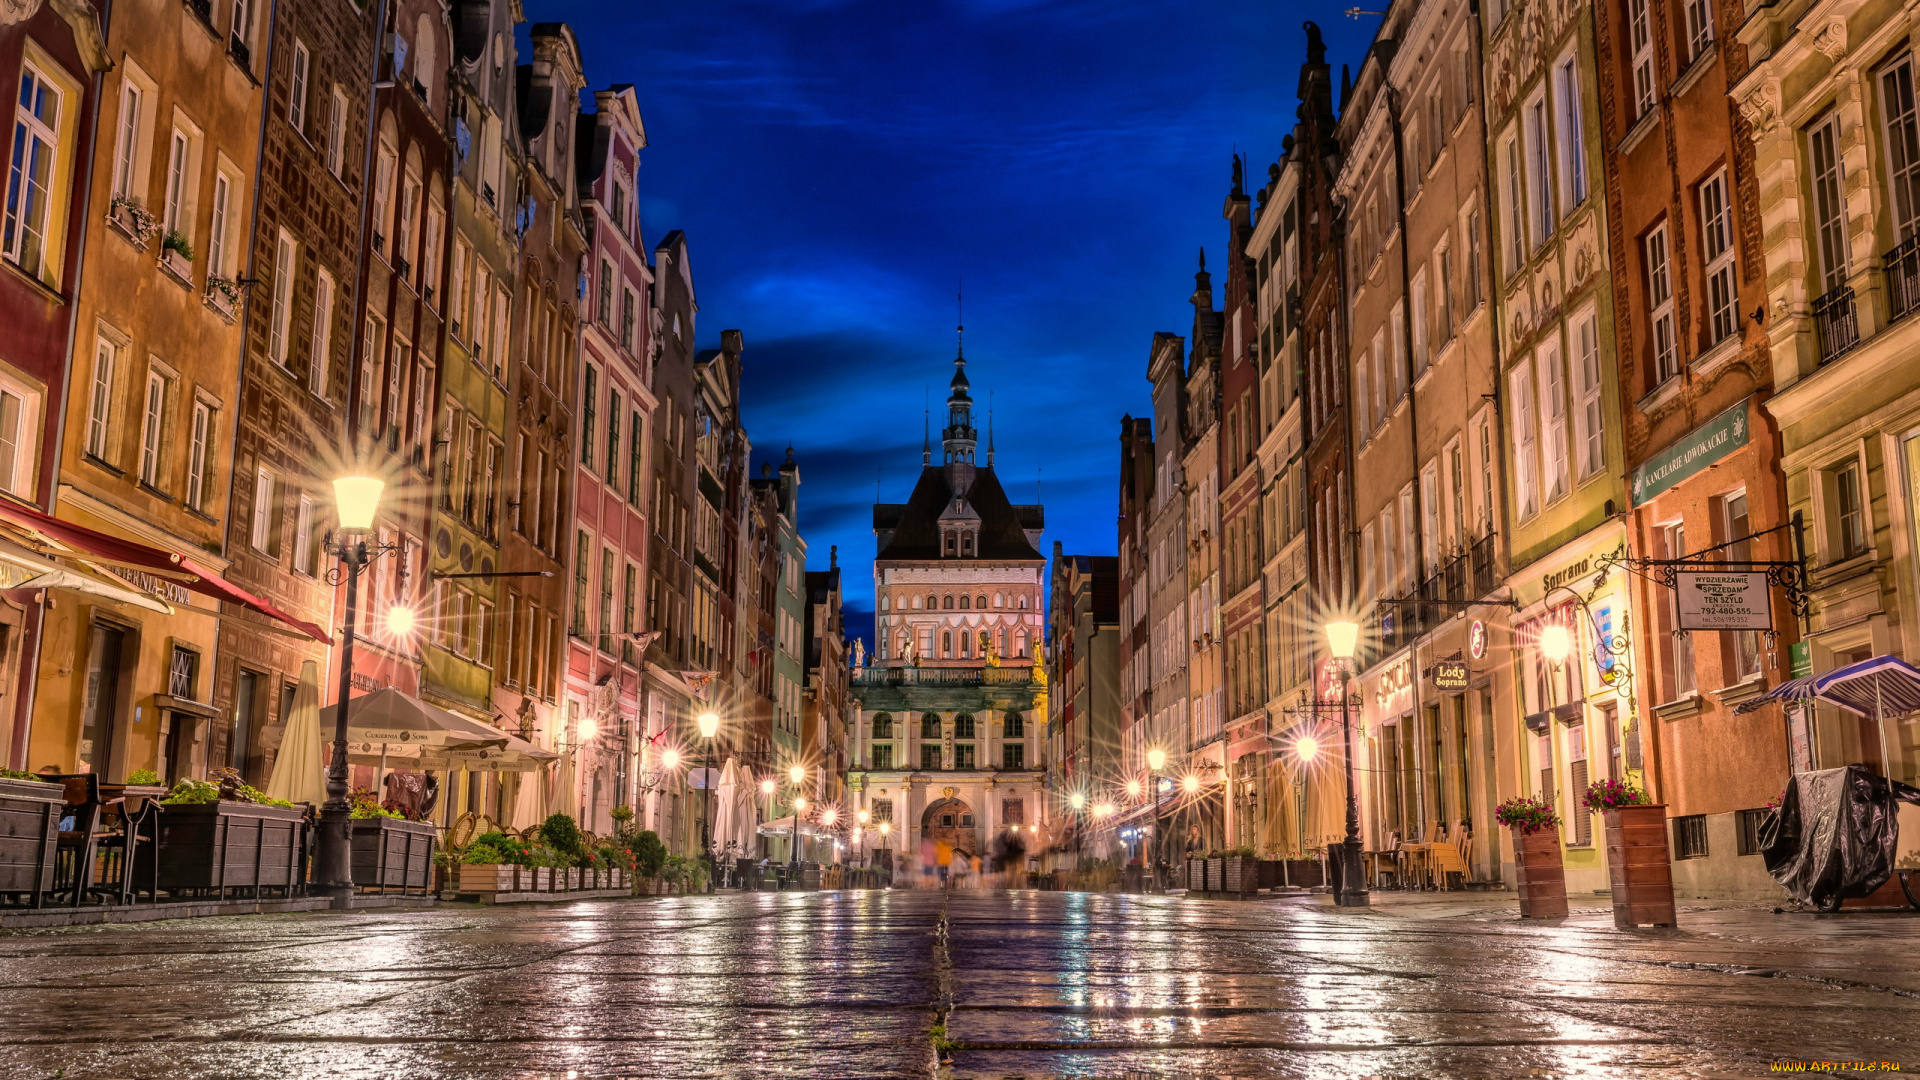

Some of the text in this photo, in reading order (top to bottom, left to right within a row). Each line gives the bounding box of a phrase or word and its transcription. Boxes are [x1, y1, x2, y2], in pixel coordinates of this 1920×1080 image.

[1645, 428, 1729, 488] KANCELARIE ADWOKACKIE
[1543, 558, 1590, 592] Soprano
[1704, 596, 1718, 604] TEN
[1701, 607, 1751, 615] 792-480-555
[1438, 665, 1465, 679] Lody
[1436, 677, 1467, 687] Soprano
